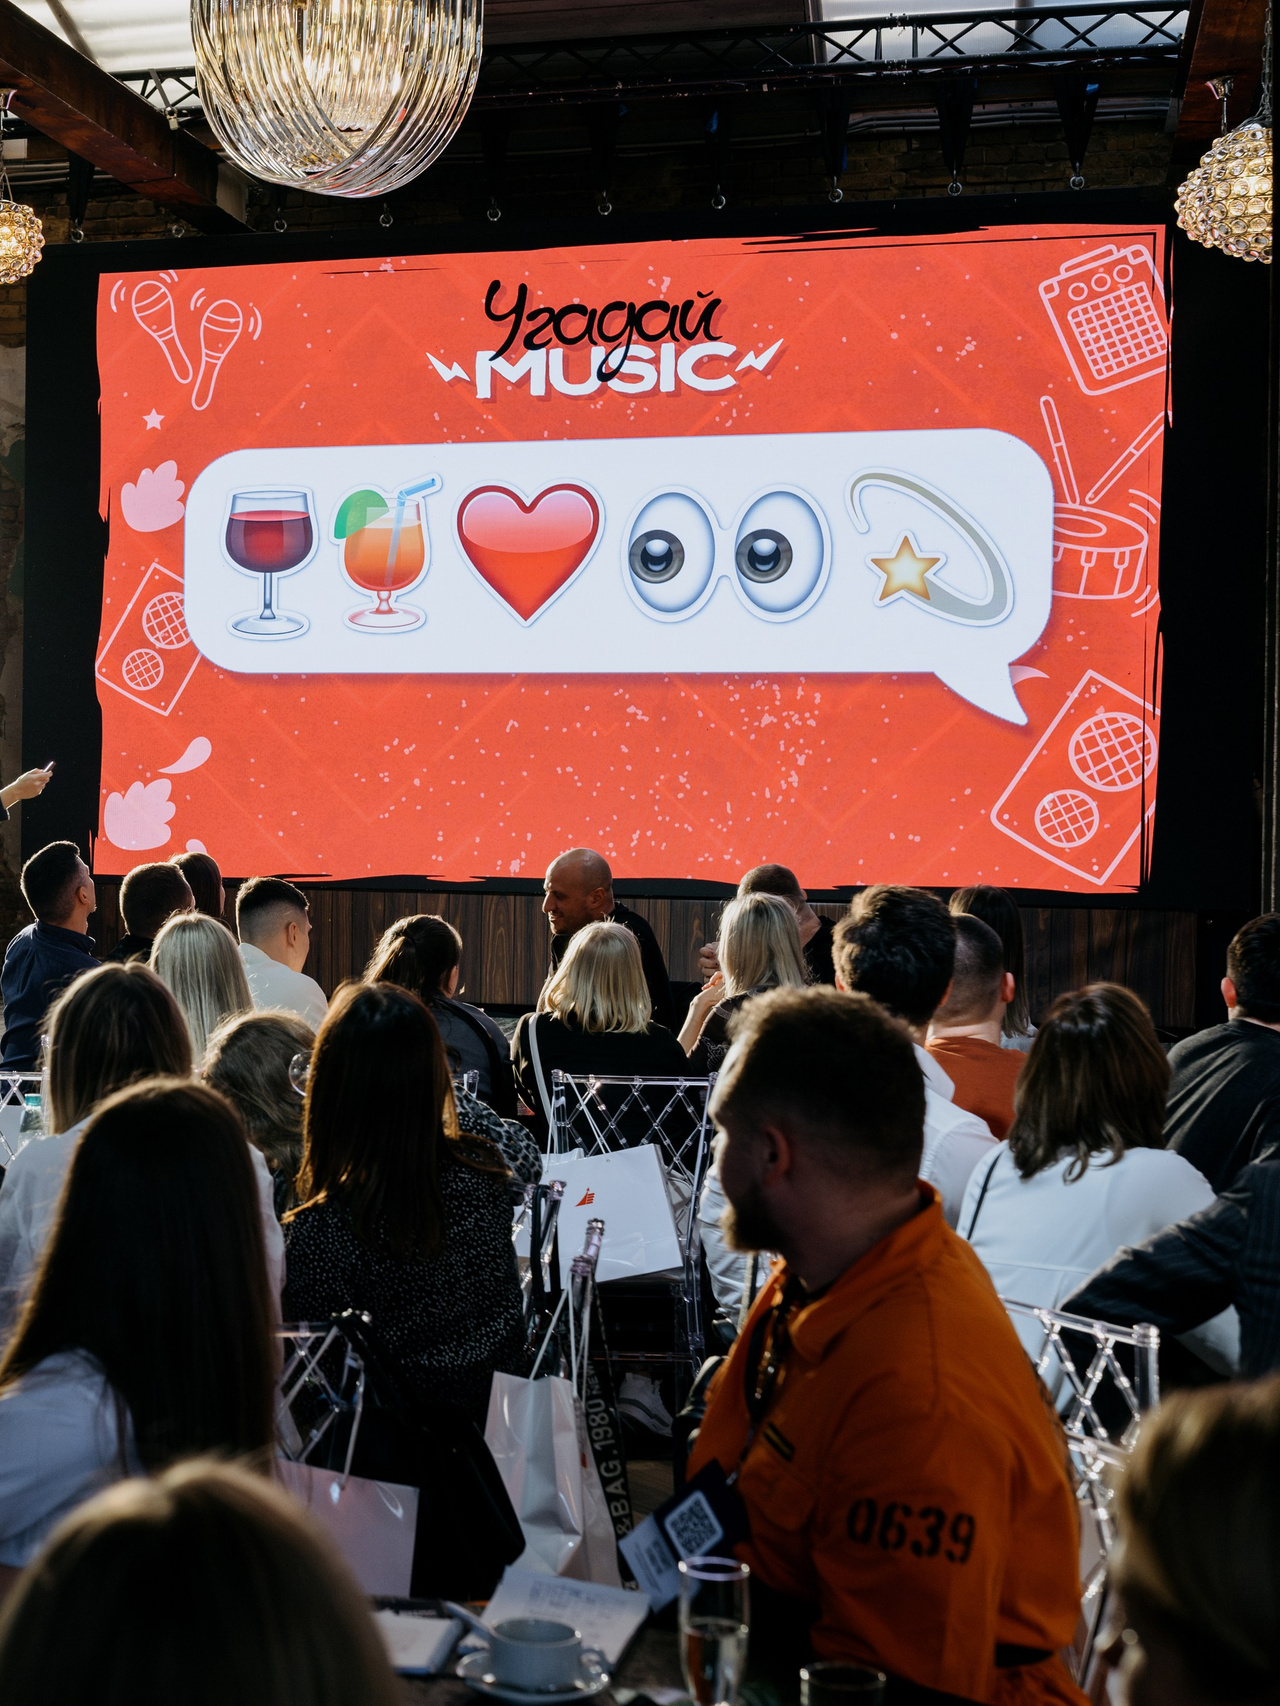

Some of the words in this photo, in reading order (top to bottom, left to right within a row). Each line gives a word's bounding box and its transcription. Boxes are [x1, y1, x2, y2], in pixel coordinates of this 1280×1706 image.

[484, 280, 723, 382] Угадай
[475, 341, 738, 399] MUSIC
[847, 1498, 975, 1564] 0639
